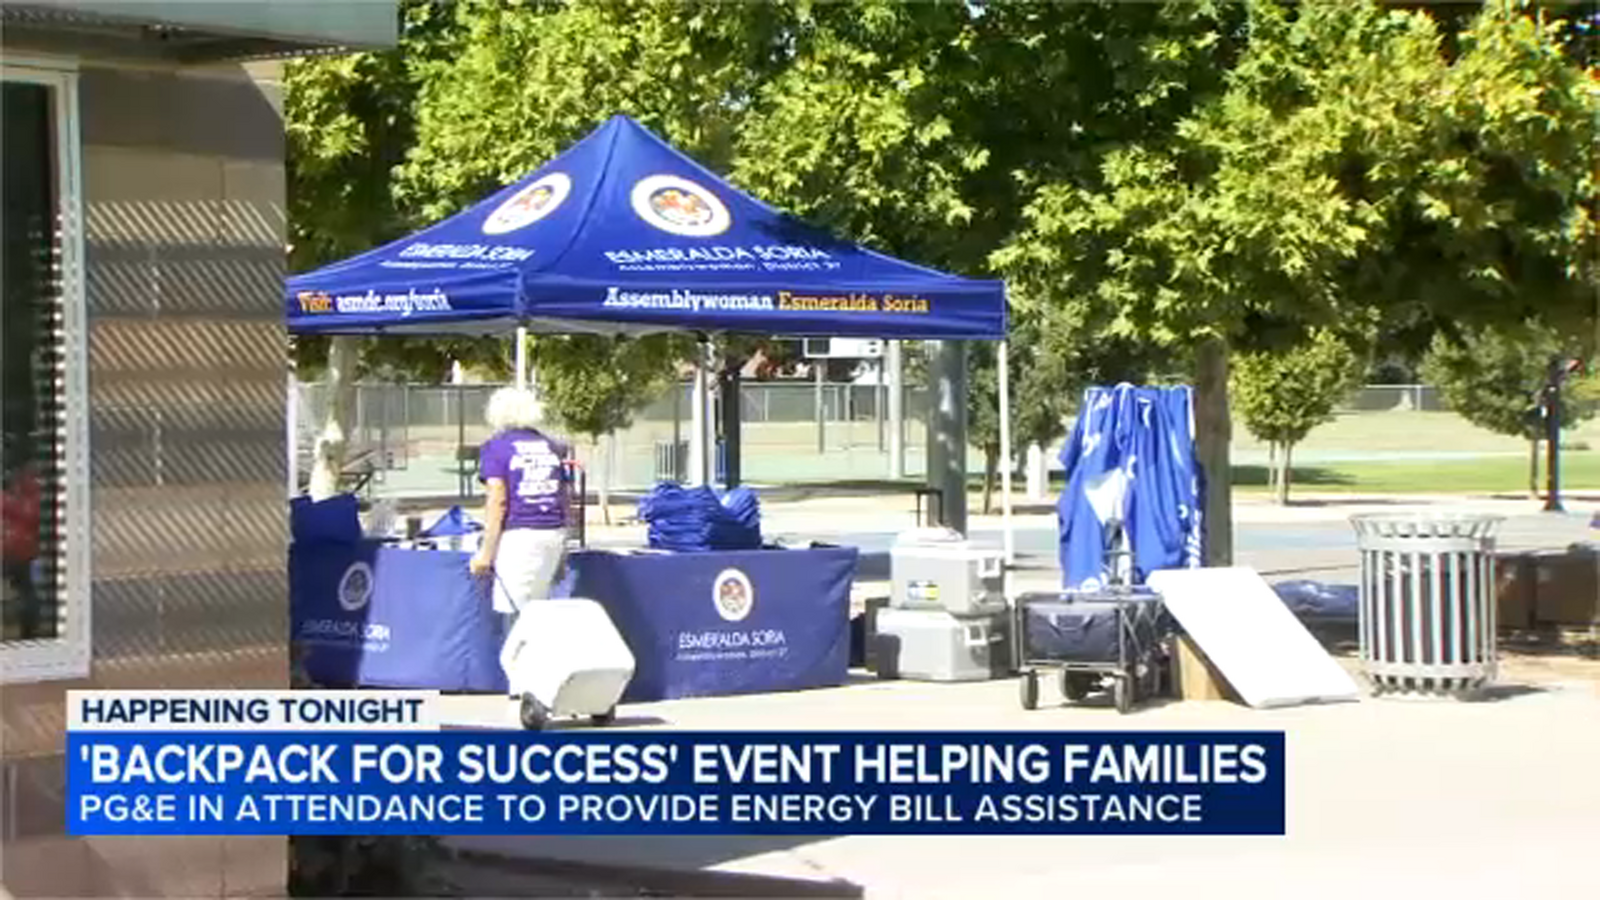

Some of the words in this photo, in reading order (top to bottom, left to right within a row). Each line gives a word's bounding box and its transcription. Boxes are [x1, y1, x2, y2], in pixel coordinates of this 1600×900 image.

[605, 246, 754, 263] ESMERALDA
[603, 286, 773, 312] Assemblywoman
[778, 290, 877, 311] Esmeralda
[883, 295, 929, 313] Soria
